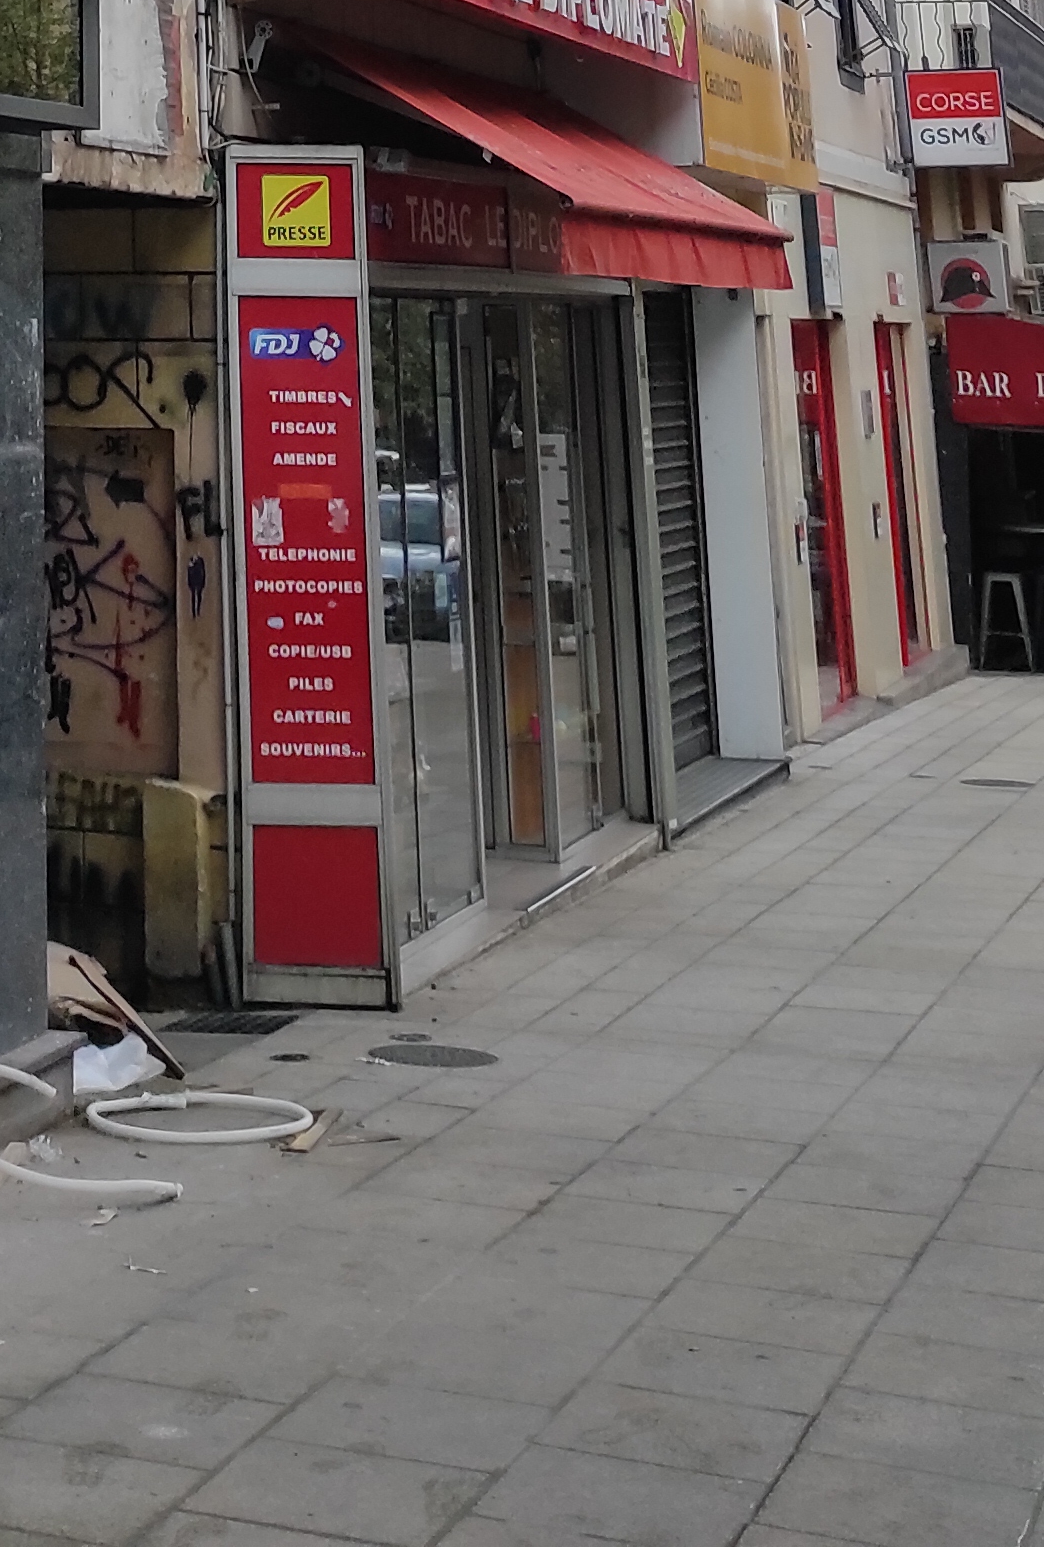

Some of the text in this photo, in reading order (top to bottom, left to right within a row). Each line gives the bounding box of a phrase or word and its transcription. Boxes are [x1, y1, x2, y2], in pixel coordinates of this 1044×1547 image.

[915, 91, 995, 112] CORSE
[405, 194, 474, 249] TABAC
[485, 204, 508, 248] LE
[267, 225, 327, 242] PRESSE
[253, 333, 301, 356] FDJ
[955, 370, 1012, 399] BAR
[269, 390, 337, 405] TIMBRES
[271, 422, 337, 436] FISCAUX
[273, 452, 337, 467] AMENDE
[258, 547, 357, 562] TELEPHONIE
[254, 579, 364, 594] PHOTOCOPIES
[294, 611, 324, 627] FAX
[268, 644, 353, 660] COPIE/USB
[288, 676, 334, 692] PILES
[273, 709, 352, 725] CARTERIE
